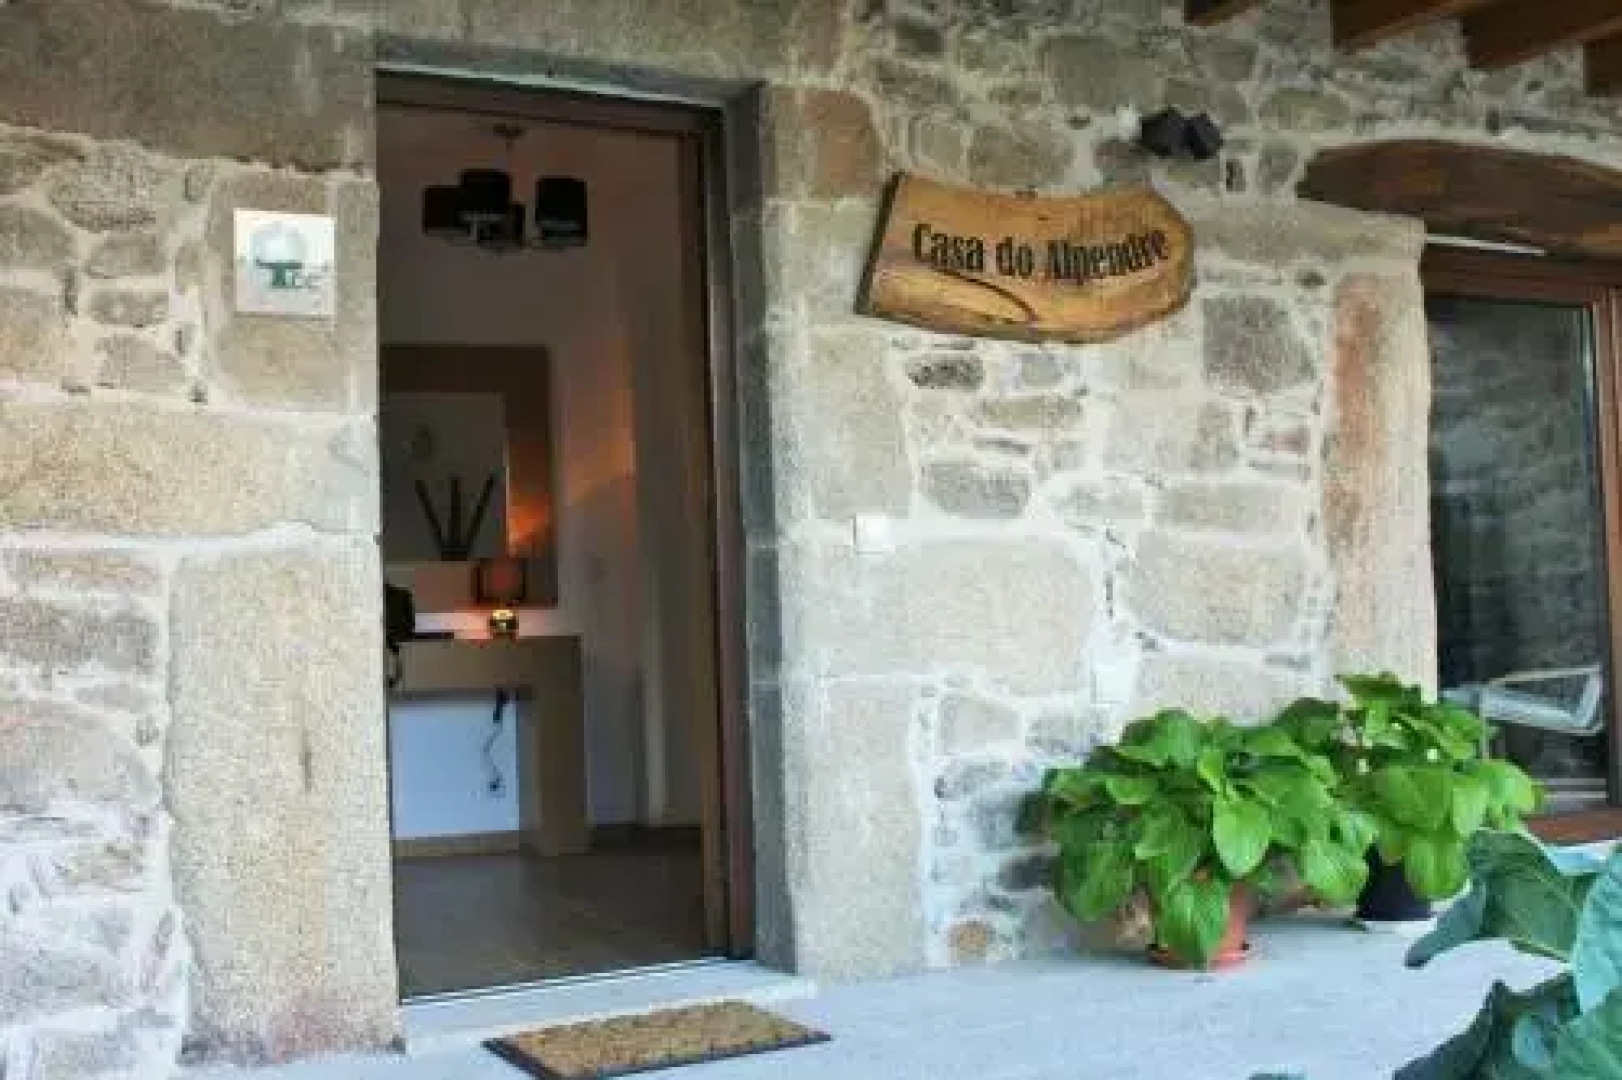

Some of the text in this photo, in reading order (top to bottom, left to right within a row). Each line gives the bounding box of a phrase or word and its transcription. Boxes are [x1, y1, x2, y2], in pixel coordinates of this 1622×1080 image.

[911, 222, 1169, 284] Casa do Alpendre
